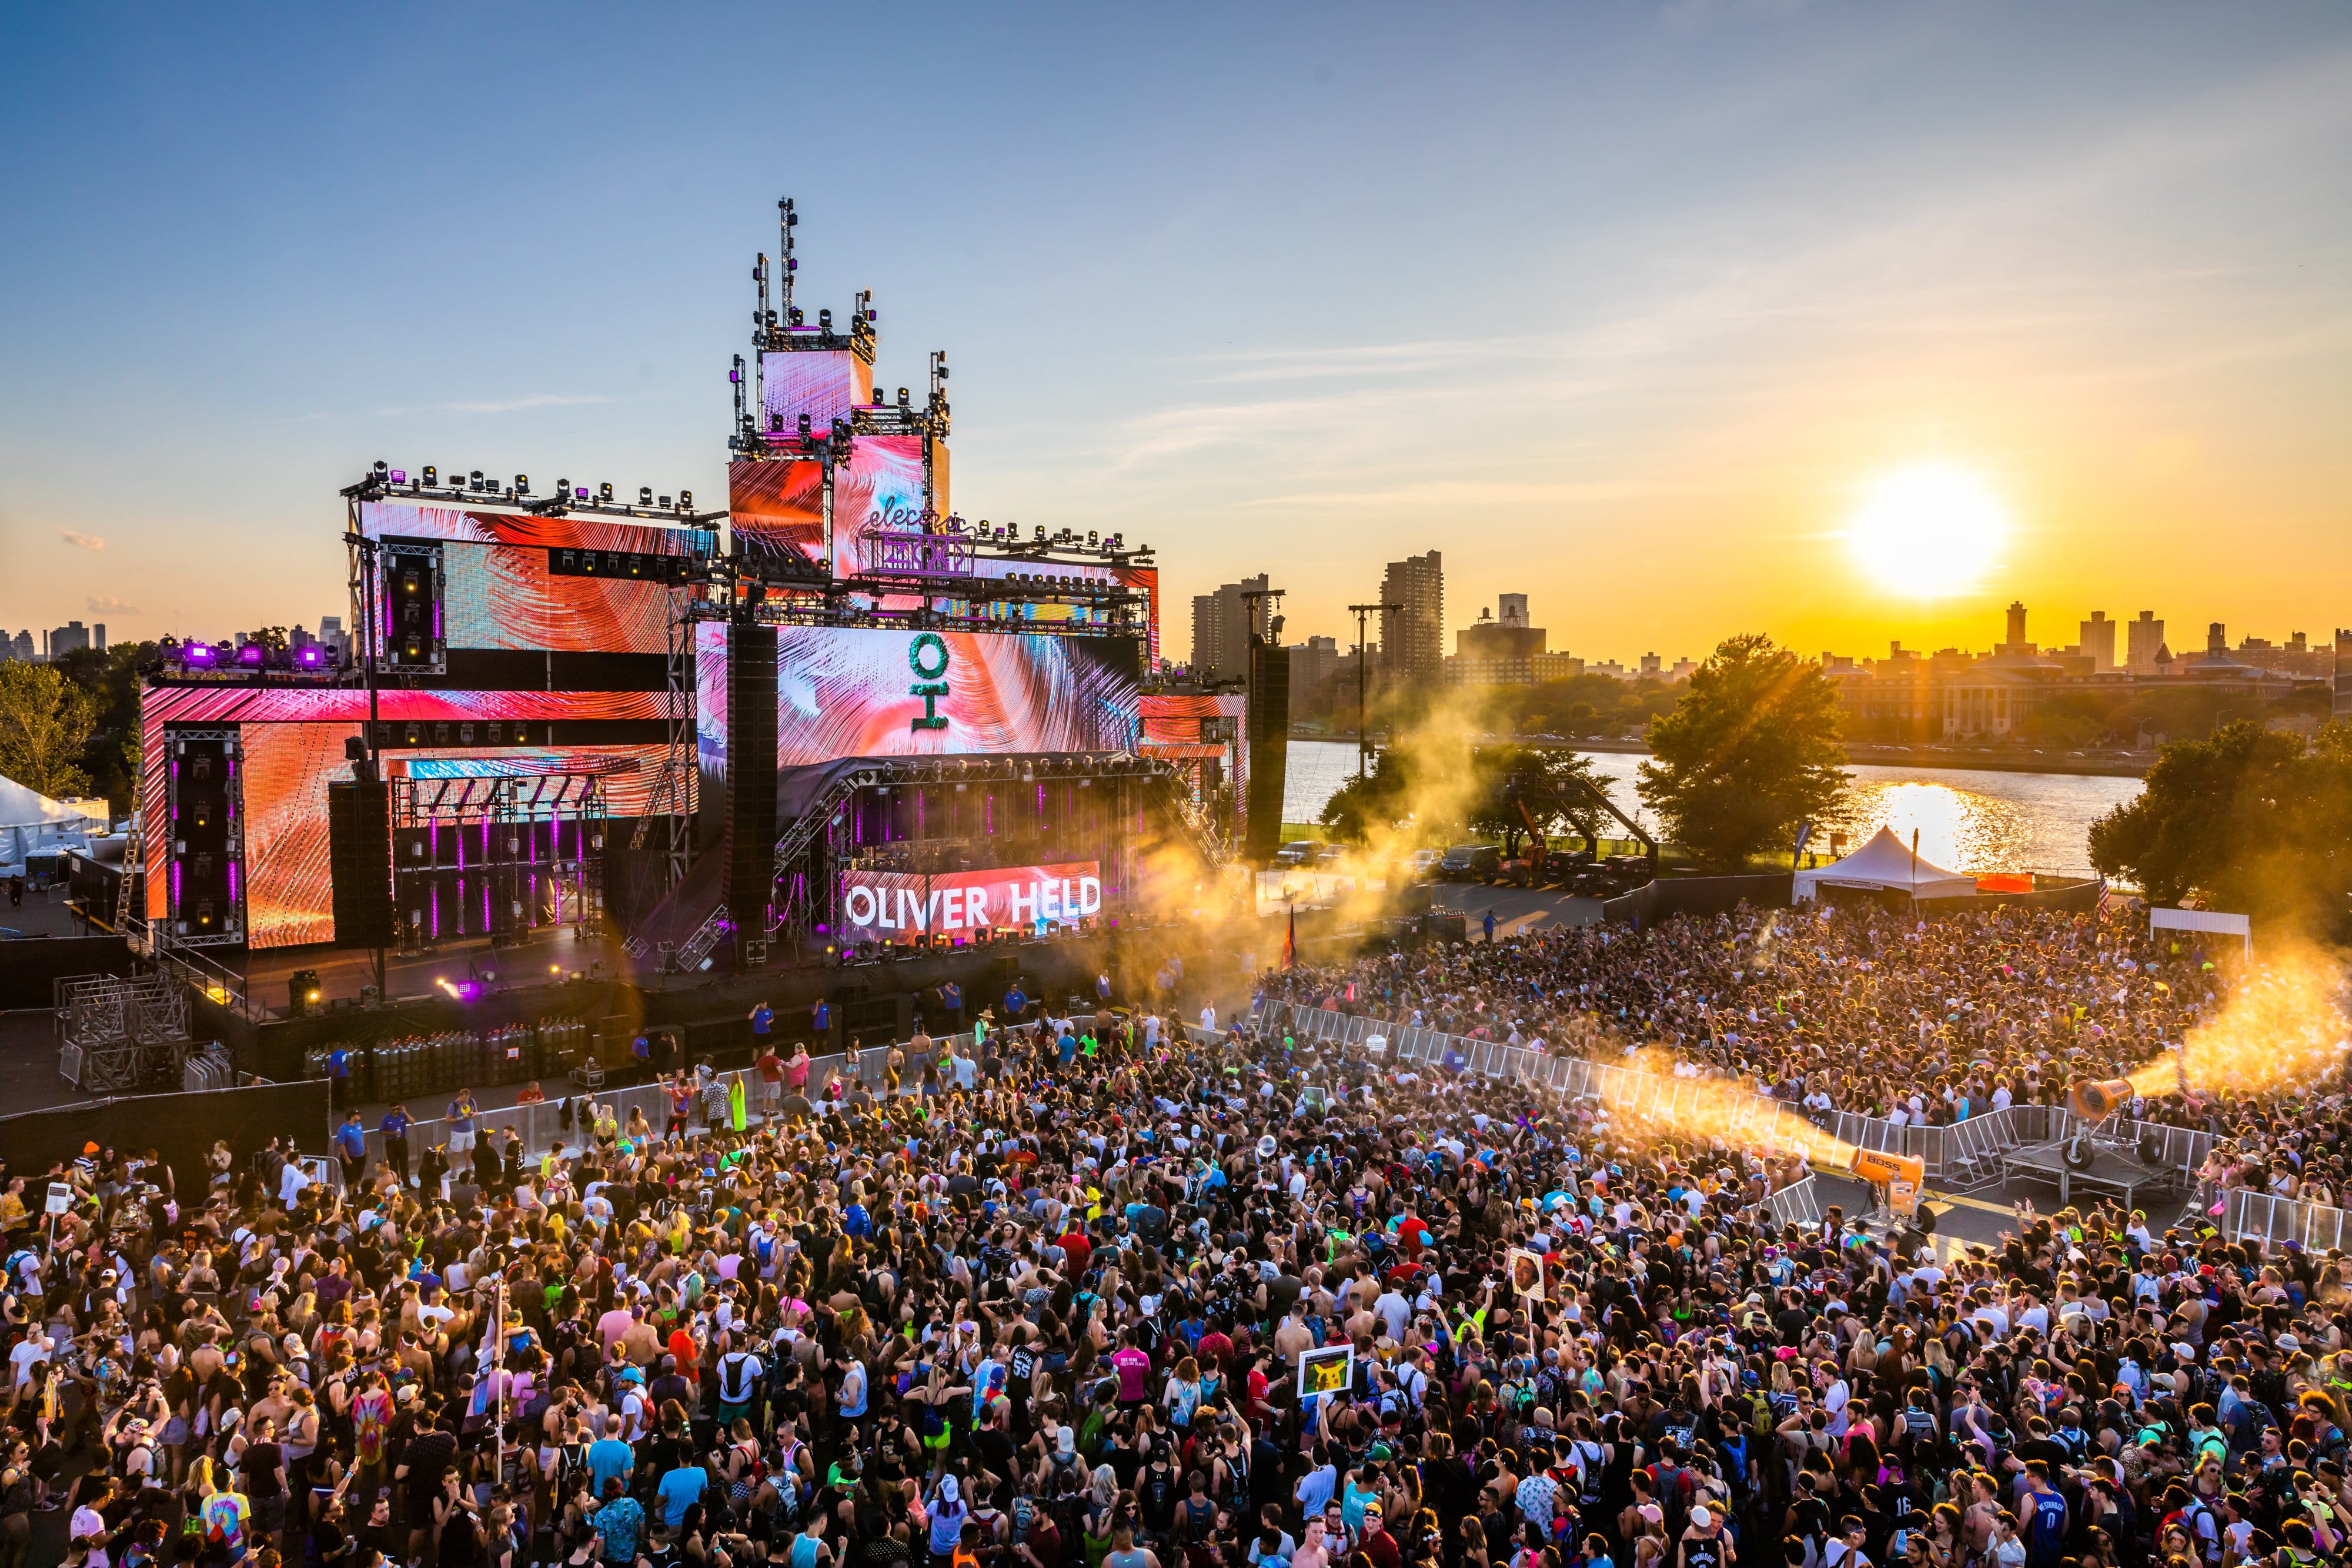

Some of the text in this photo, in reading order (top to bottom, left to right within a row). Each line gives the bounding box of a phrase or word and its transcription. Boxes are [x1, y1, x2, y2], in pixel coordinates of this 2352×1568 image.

[870, 495, 966, 533] electric
[846, 877, 1100, 931] OLIVER HELD
[1866, 1155, 1900, 1172] BOSS
[1014, 1351, 1033, 1366] WILLIAMS
[1013, 1359, 1031, 1379] 55
[1896, 1496, 1911, 1517] 16
[2037, 1501, 2064, 1512] WESTBROOK
[2046, 1512, 2056, 1529] 0
